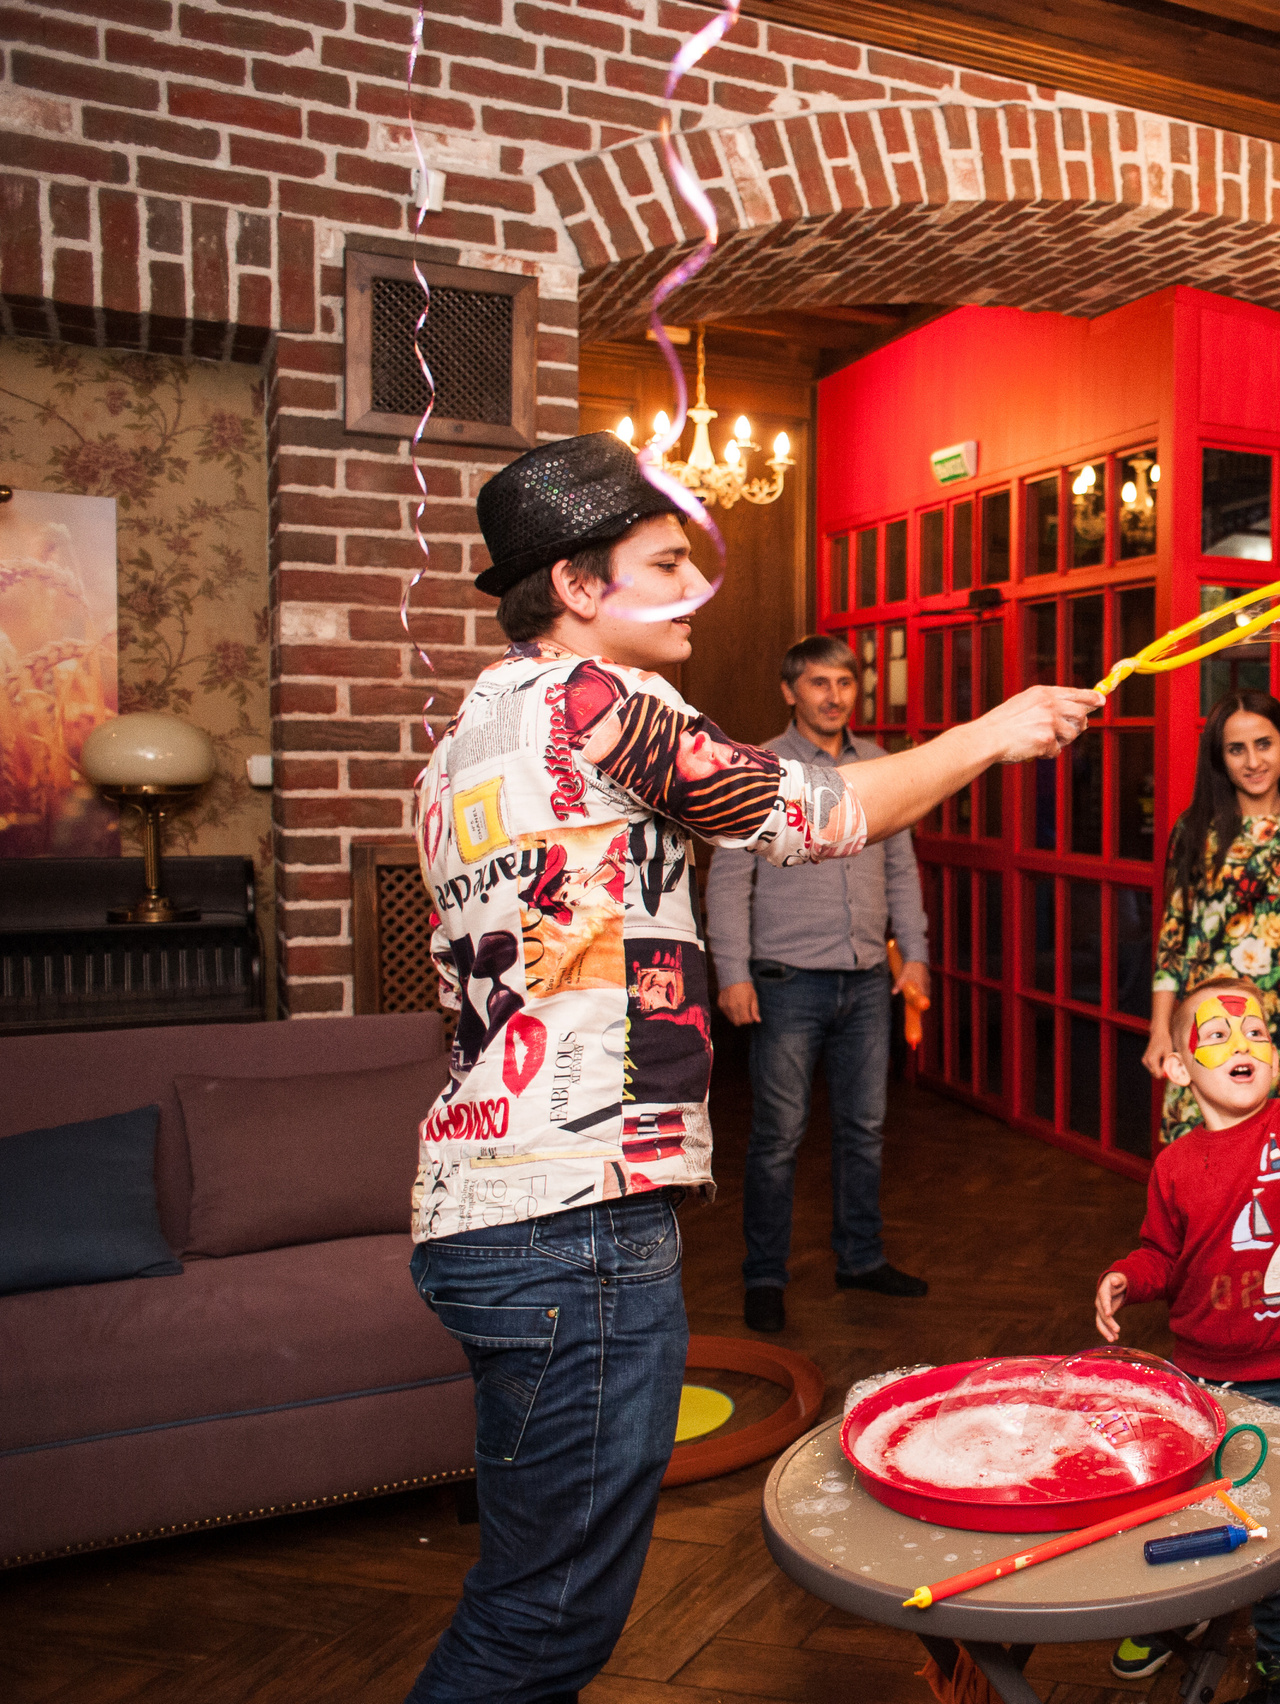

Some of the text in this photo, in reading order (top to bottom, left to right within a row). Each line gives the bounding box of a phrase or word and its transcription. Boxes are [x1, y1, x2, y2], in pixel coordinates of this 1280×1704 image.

[472, 807, 483, 841] CHANEL
[550, 1031, 578, 1123] FABULOUS
[571, 1043, 585, 1086] AT EVERY
